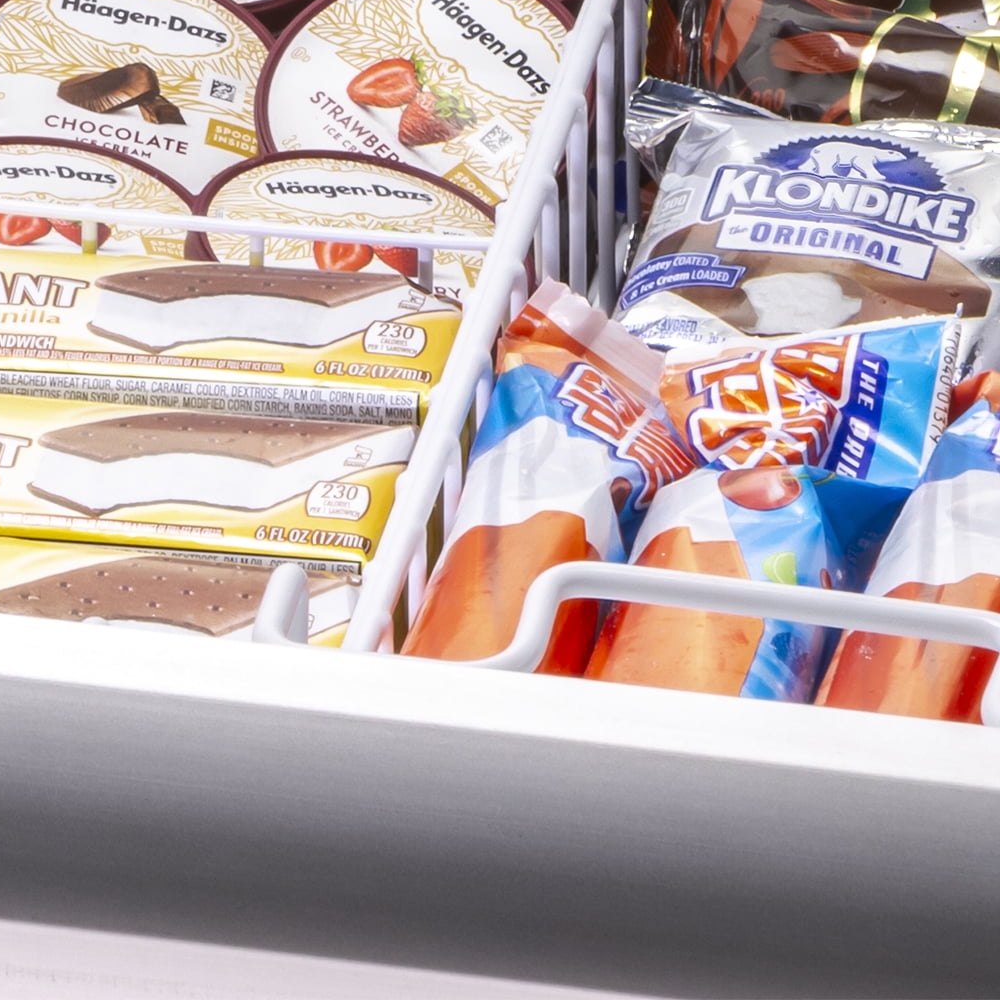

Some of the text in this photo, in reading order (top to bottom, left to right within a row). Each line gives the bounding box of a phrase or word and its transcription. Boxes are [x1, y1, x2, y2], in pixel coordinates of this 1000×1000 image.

[43, 114, 190, 156] CHOCOLATE
[265, 181, 434, 203] Häagen-Dazs
[706, 168, 970, 240] KLONDIKE
[749, 221, 903, 266] ORIGINAL
[672, 255, 709, 267] COATED
[640, 269, 730, 293] Ice Cream LOADED
[378, 323, 416, 341] 230
[314, 361, 327, 375] 6
[328, 363, 345, 376] FL
[348, 364, 370, 378] OZ
[49, 376, 80, 389] WHEAT
[81, 377, 113, 391] FLOUR,
[115, 379, 149, 392] SUGAR,
[151, 381, 194, 395] CARAMEL
[195, 384, 229, 398] COLOR,
[231, 385, 279, 399] DEXTROSE,
[283, 388, 309, 401] PALM
[329, 391, 356, 404] CORN
[356, 393, 388, 406] FLOUR,
[389, 394, 413, 406] LESS
[857, 359, 881, 412] THE
[122, 393, 150, 406] CORN
[150, 395, 180, 408] SYRUP,
[182, 397, 226, 411] MODIFIED
[227, 399, 254, 412] CORN
[254, 400, 292, 415] STARCH,
[293, 402, 328, 416] BAKING
[329, 404, 355, 417] SODA,
[358, 405, 383, 418] SALT,
[384, 407, 413, 420] MONO
[320, 484, 359, 499] 230
[255, 526, 309, 544] 6 FL OZ
